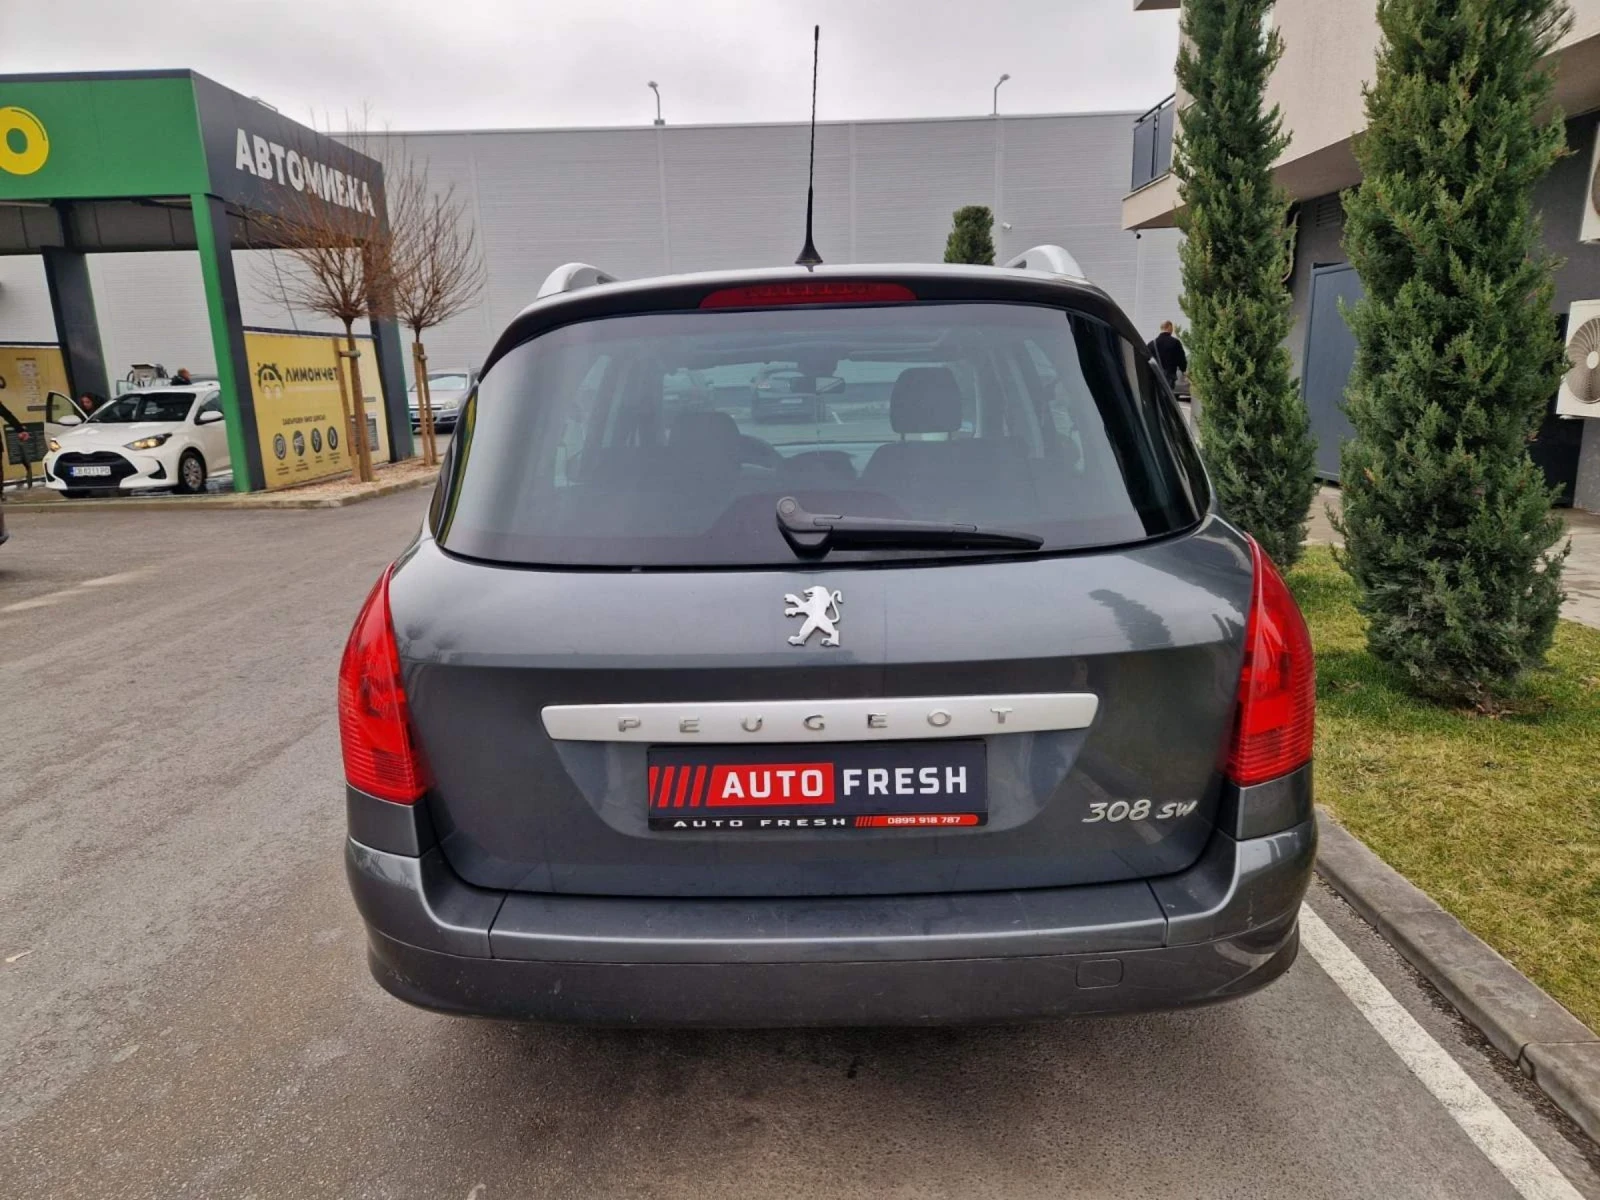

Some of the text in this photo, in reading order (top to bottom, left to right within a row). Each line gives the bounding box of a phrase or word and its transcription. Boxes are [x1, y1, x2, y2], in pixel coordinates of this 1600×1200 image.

[617, 707, 1013, 733] PEUGEOT
[721, 766, 967, 799] AUTO FRESH
[673, 817, 846, 828] AUTO FRESH
[887, 815, 961, 825] 0899 918 787
[1081, 799, 1198, 823] 308 SW
